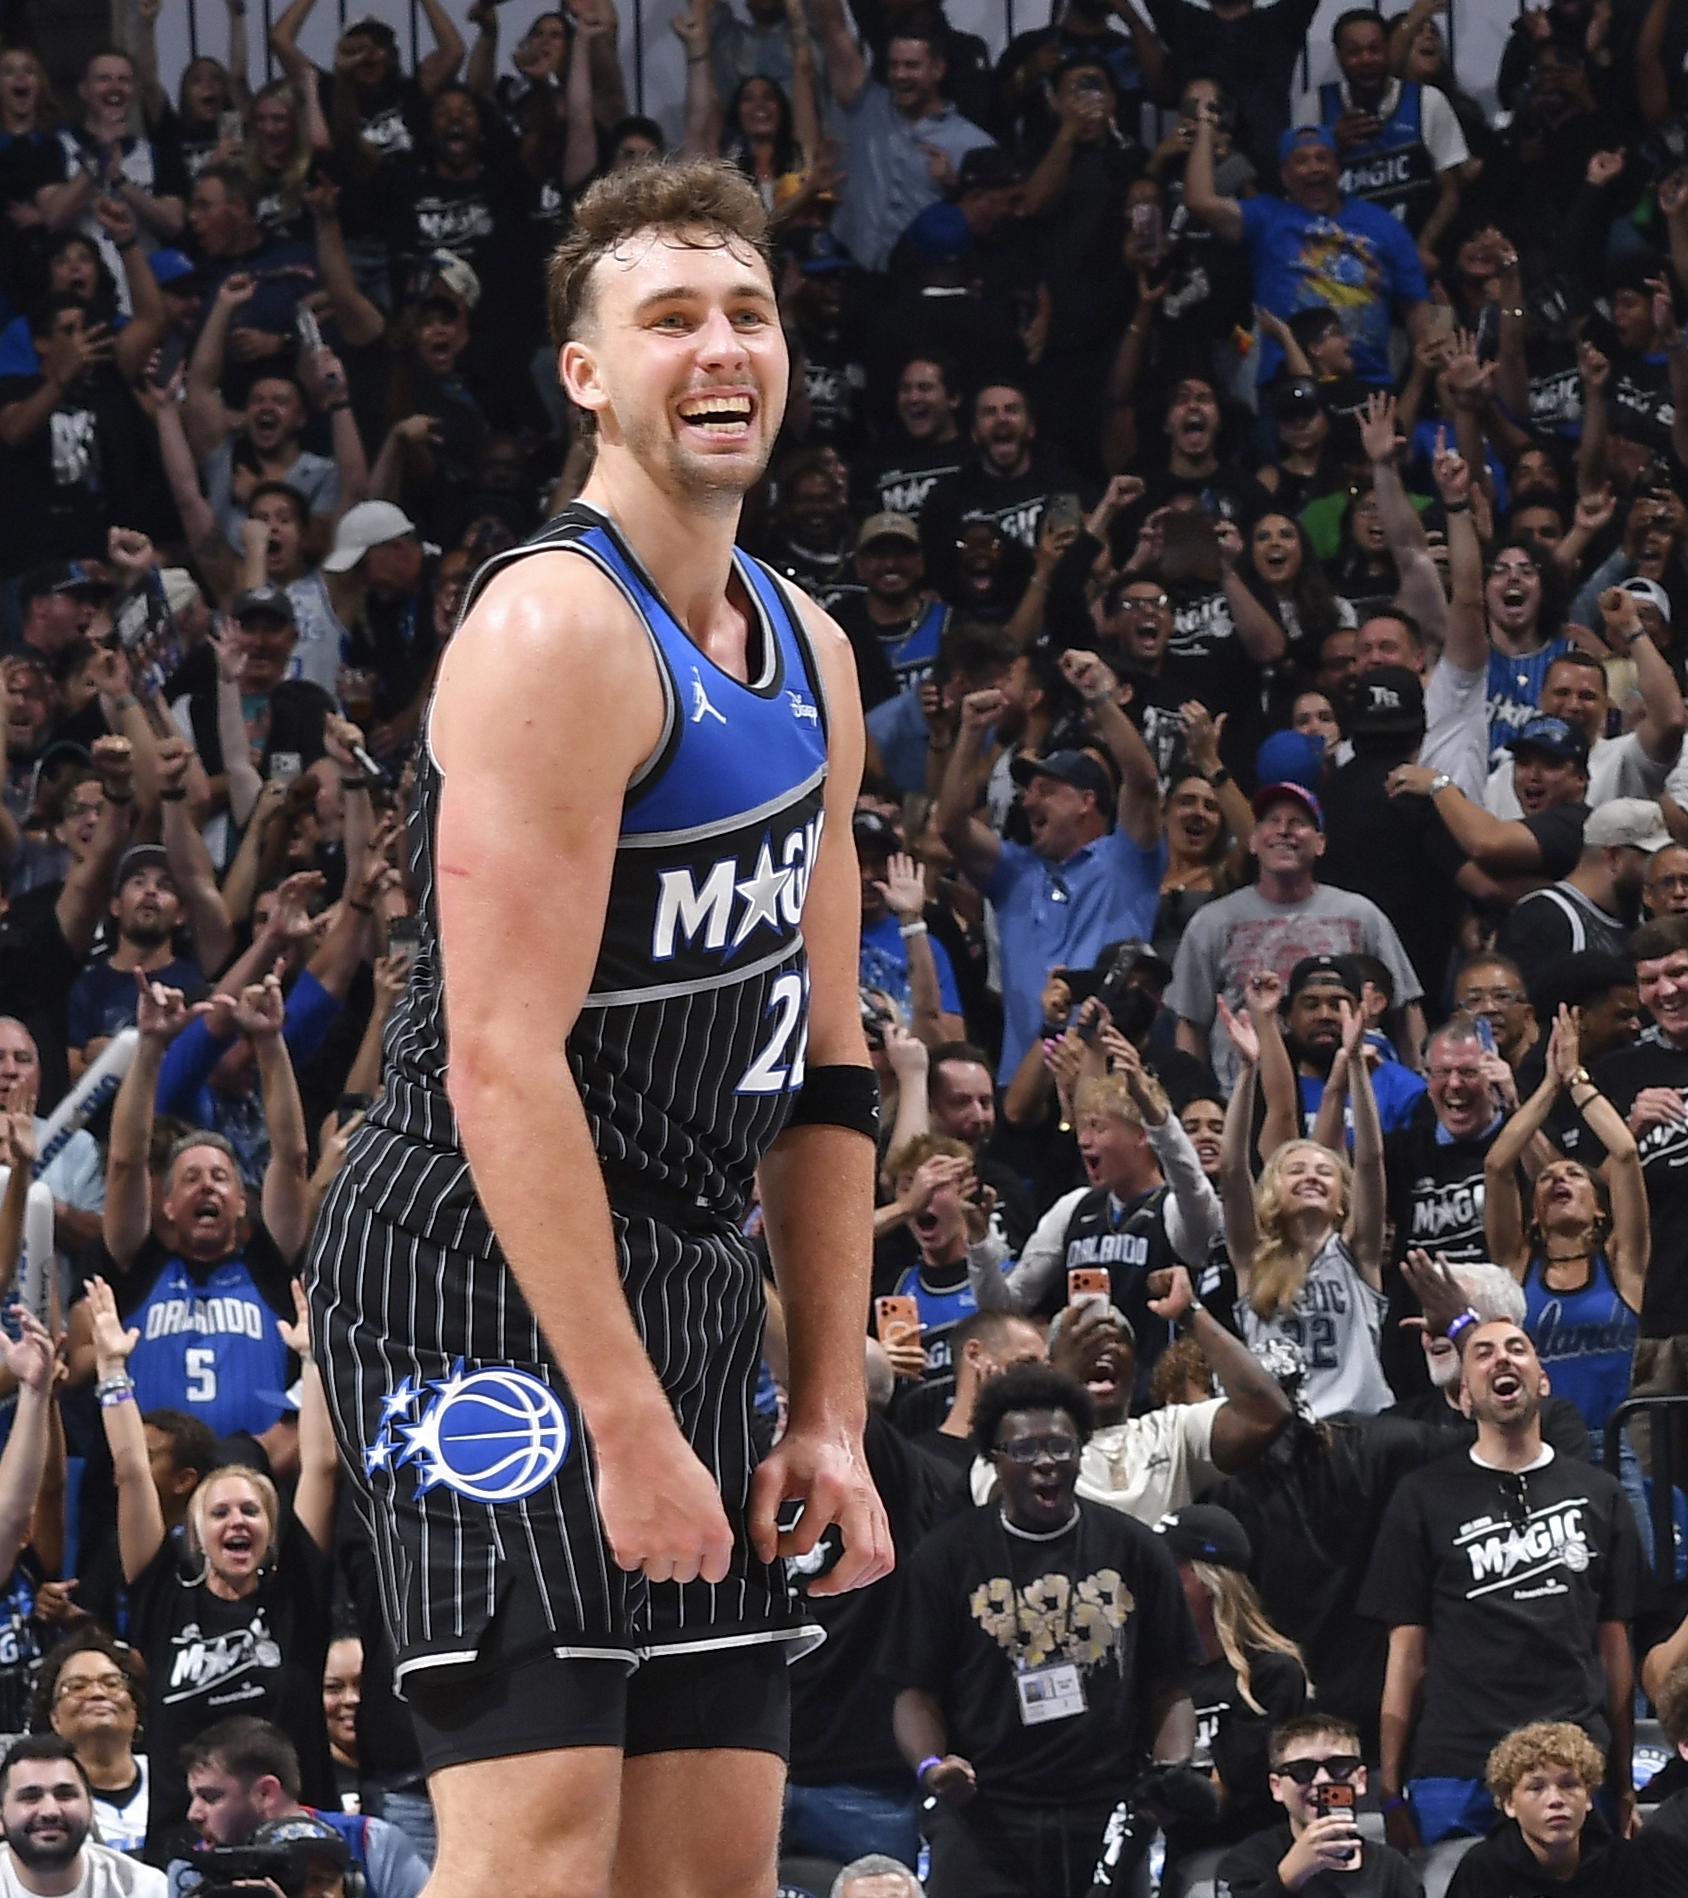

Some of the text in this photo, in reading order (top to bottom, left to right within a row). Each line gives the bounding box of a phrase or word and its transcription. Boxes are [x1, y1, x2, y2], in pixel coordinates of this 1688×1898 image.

[145, 1296, 263, 1341] ORLANDO
[184, 1347, 218, 1403] 5
[1467, 1507, 1586, 1581] MAGIC
